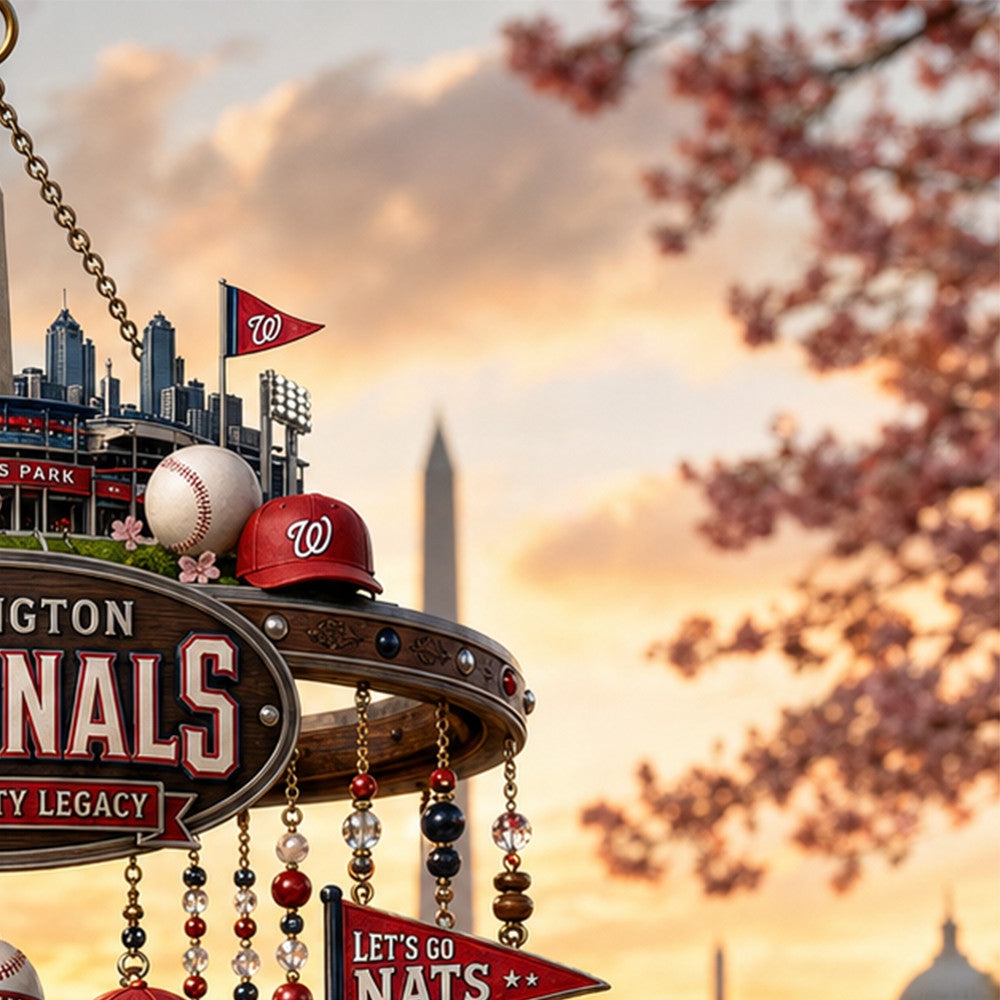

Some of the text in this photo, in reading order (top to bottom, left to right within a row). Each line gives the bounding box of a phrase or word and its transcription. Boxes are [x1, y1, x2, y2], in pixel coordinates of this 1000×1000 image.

[247, 313, 283, 346] W
[19, 464, 76, 484] PARK
[286, 514, 333, 558] W
[38, 790, 150, 819] LEGACY
[353, 931, 454, 962] LET'S GO
